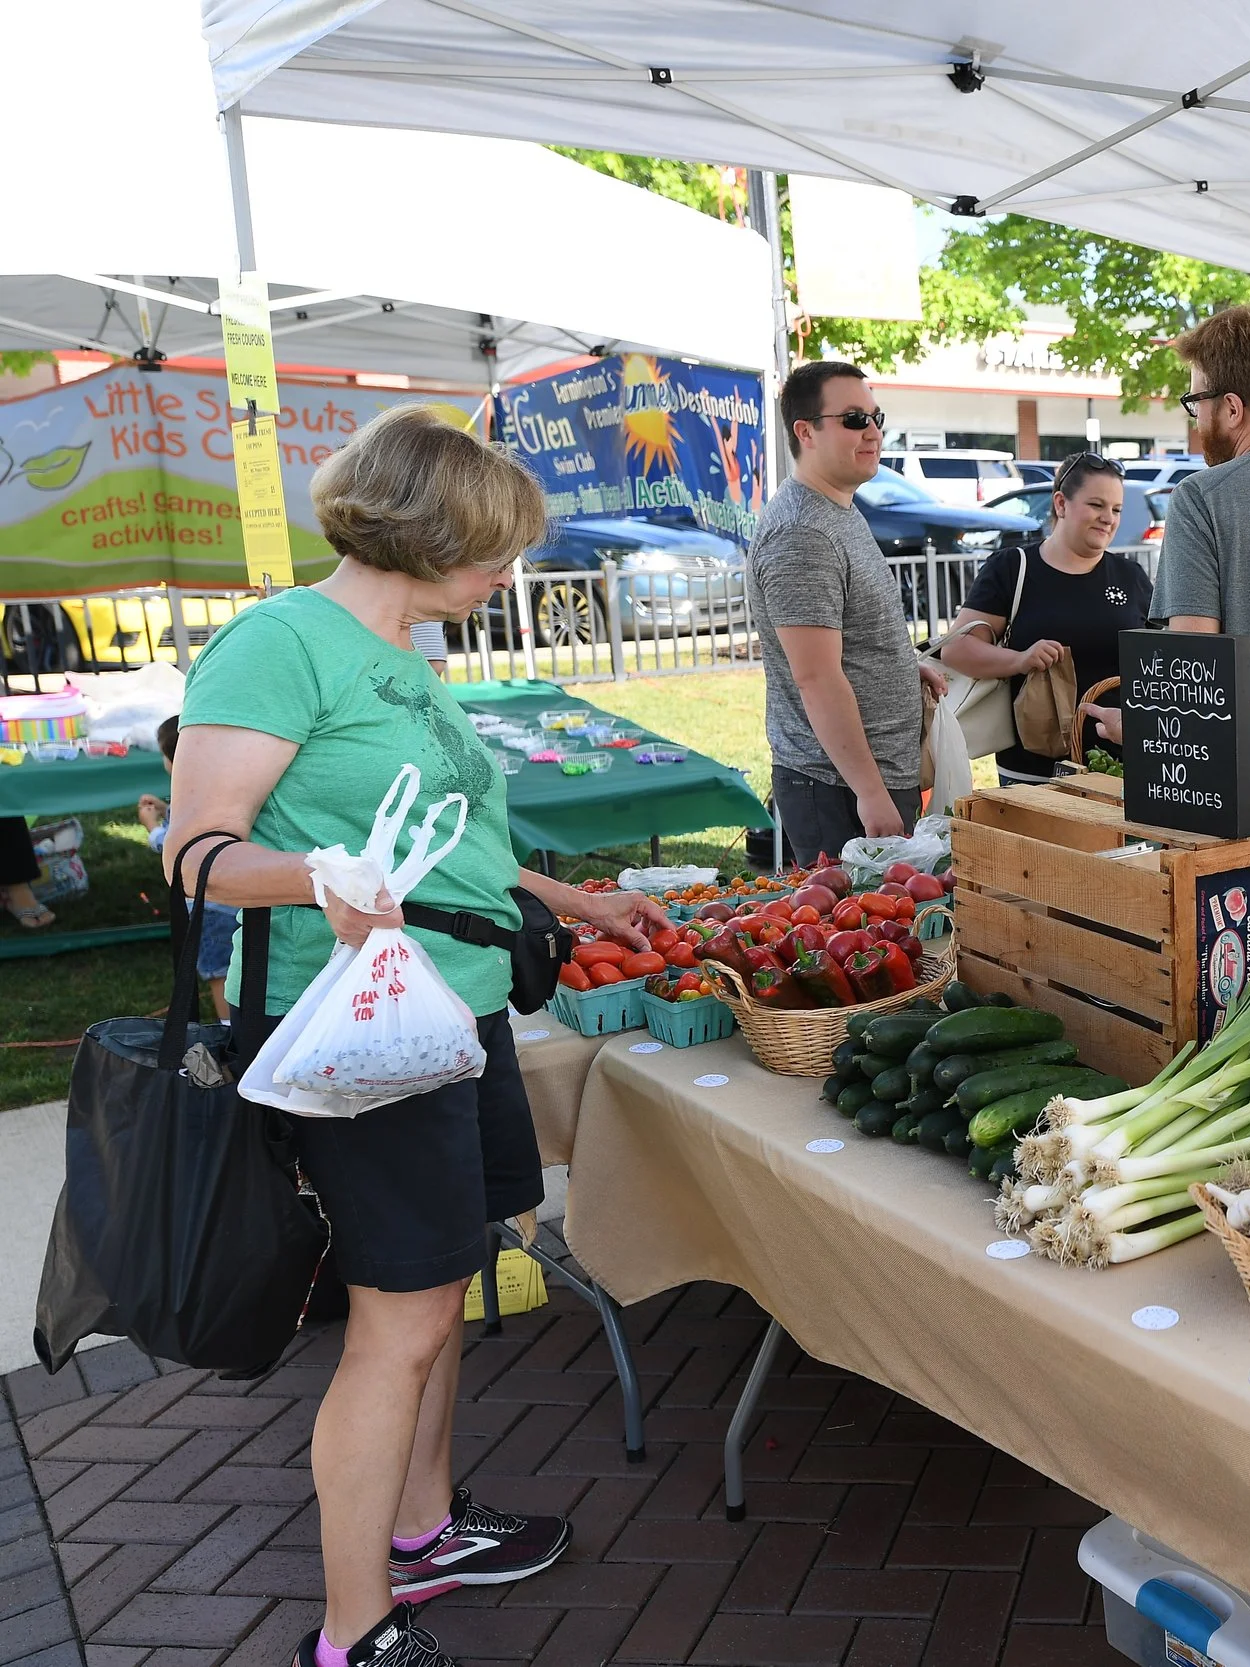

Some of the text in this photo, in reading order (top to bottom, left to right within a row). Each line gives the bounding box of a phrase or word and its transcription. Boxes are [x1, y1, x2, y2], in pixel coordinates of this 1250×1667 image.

[227, 332, 266, 347] FRESH COUPONS
[231, 372, 268, 389] WELCOME HERE
[551, 367, 617, 405] Farmington's
[84, 381, 358, 433] Little Spouts
[677, 382, 760, 427] Destination!
[513, 389, 577, 456] Glen
[110, 422, 333, 466] Kids Cne
[574, 451, 596, 474] Club
[61, 491, 147, 527] crafts!
[92, 523, 223, 550] activities!
[1139, 656, 1217, 684] WE GROW
[1132, 679, 1226, 706] EVERYTHING
[1157, 716, 1182, 740] NO
[1142, 738, 1210, 762] PESTICIDES
[1161, 763, 1188, 785] NO
[1148, 782, 1224, 810] HERBICIDES
